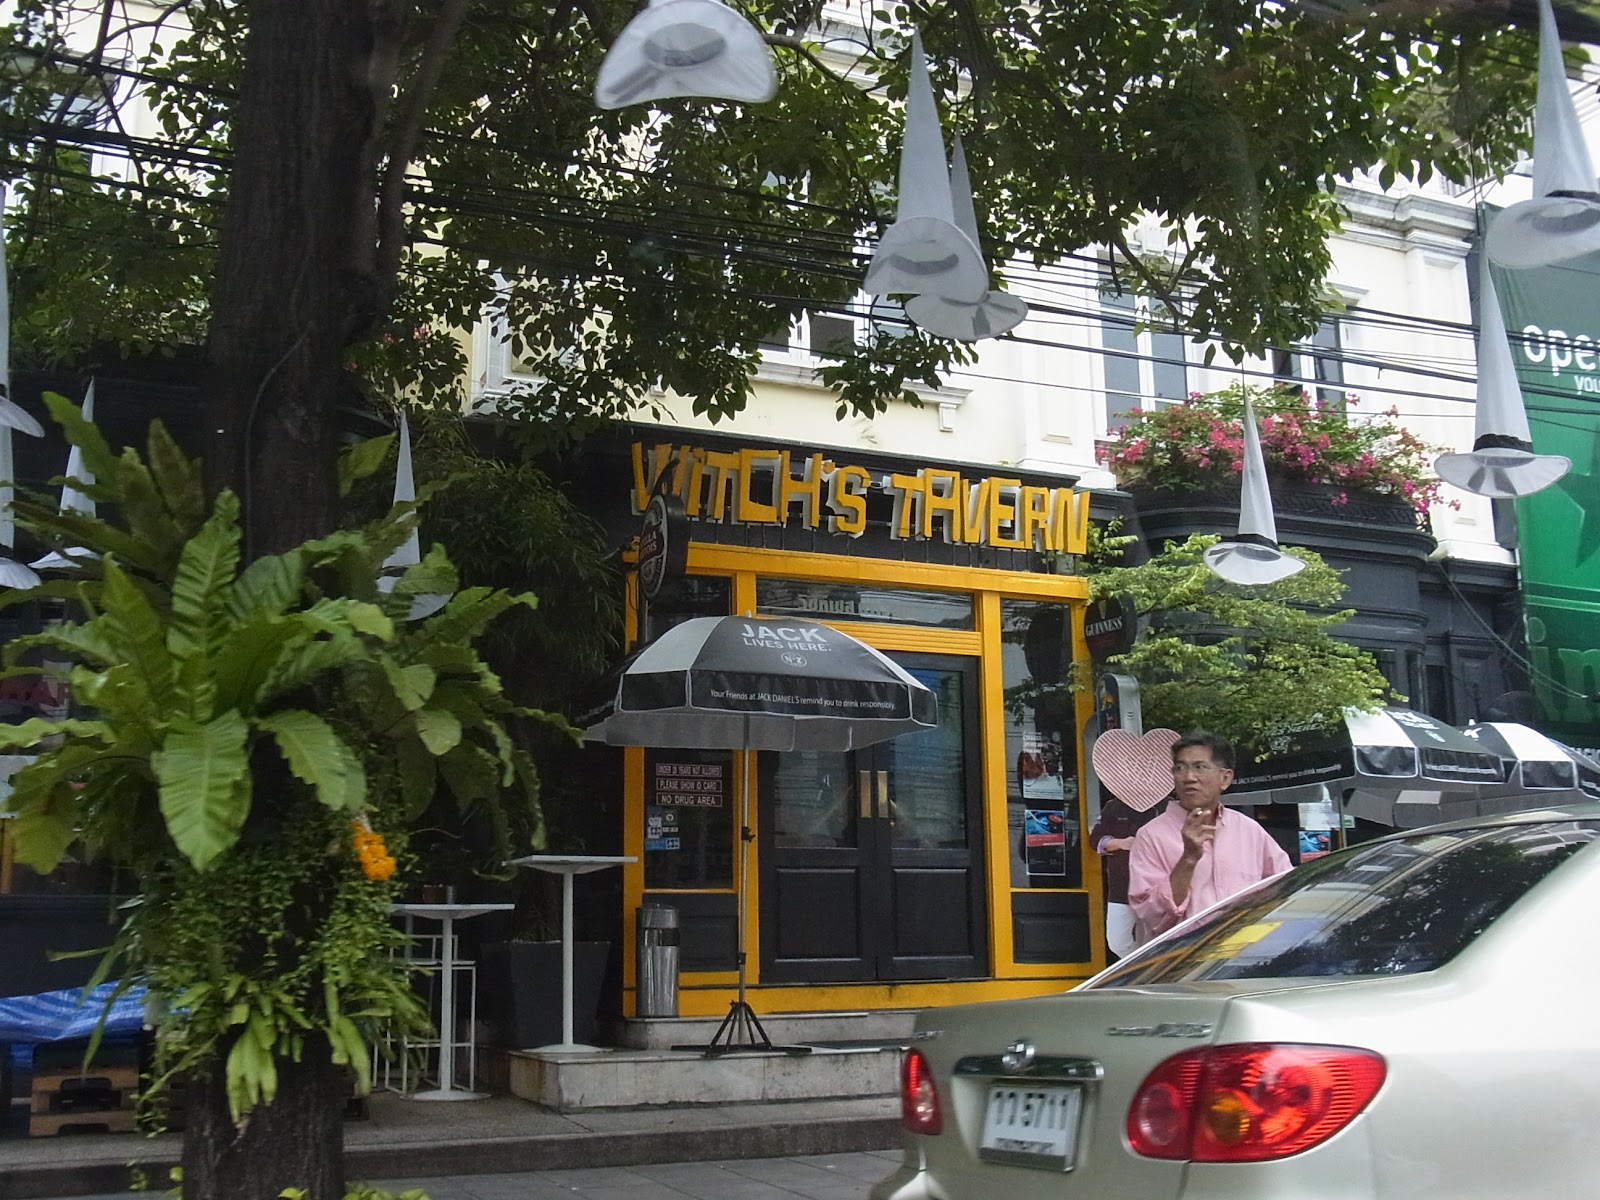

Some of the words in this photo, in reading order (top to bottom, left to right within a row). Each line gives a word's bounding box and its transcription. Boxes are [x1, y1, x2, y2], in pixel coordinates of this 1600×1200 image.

[1523, 325, 1600, 376] ope
[891, 467, 1090, 555] TAVERN
[742, 624, 827, 642] JACK
[1086, 617, 1122, 637] GUINNESS
[743, 638, 783, 649] LIVES
[711, 690, 725, 698] Your
[726, 691, 748, 700] Friends
[757, 693, 771, 702] JACK
[772, 694, 799, 704] DANIEL'S
[800, 697, 822, 705] remind
[843, 699, 858, 707] drink
[661, 795, 672, 804] NO
[675, 795, 694, 805] DRUG
[697, 796, 716, 805] AREA
